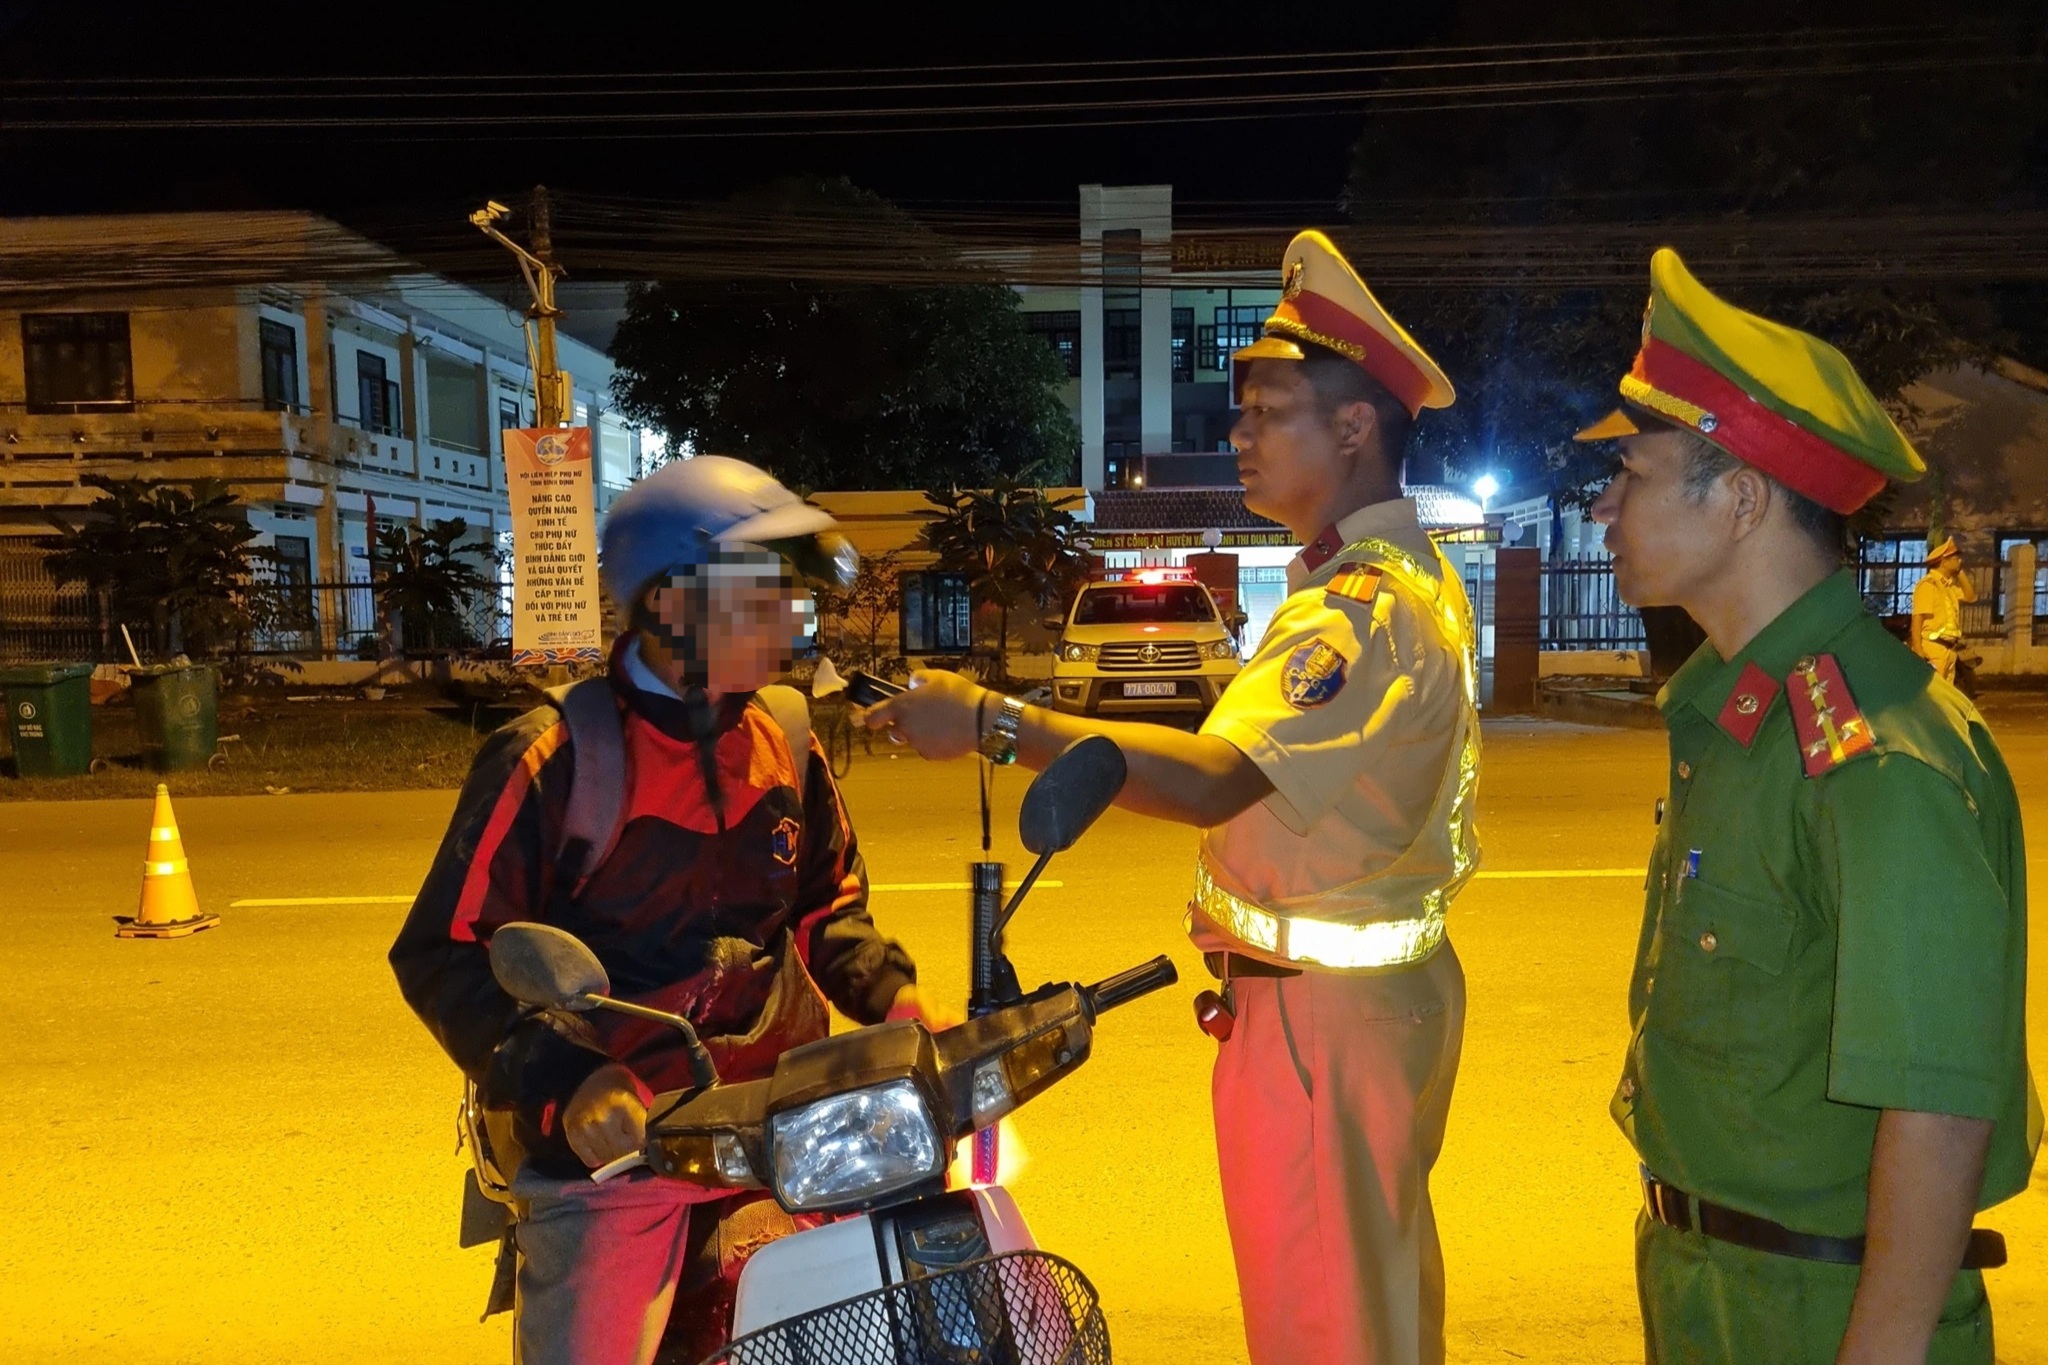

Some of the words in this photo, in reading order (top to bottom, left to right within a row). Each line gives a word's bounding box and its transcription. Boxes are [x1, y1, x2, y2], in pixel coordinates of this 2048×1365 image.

[532, 493, 552, 503] NÂNG
[555, 494, 571, 503] CAO
[537, 518, 555, 527] KINH
[557, 516, 567, 526] TẾ
[530, 531, 543, 539] CHO
[546, 531, 562, 540] PHỤ
[1152, 536, 1164, 547] AN
[1166, 534, 1192, 548] HUYỆN
[1236, 534, 1249, 545] THI
[1268, 533, 1285, 545] HỌC
[535, 541, 554, 551] THÚC
[525, 554, 542, 563] BÌNH
[569, 553, 585, 562] GIỚI
[528, 565, 537, 574] VÀ
[539, 565, 555, 574] GIẢI
[557, 564, 582, 574] QUYẾT
[555, 576, 571, 586] VẤN
[535, 588, 551, 598] CẤP
[554, 588, 576, 598] THIẾT
[540, 601, 554, 610] VỚI
[556, 601, 572, 611] PHỤ
[535, 613, 546, 622] VÀ
[565, 613, 577, 622] EM
